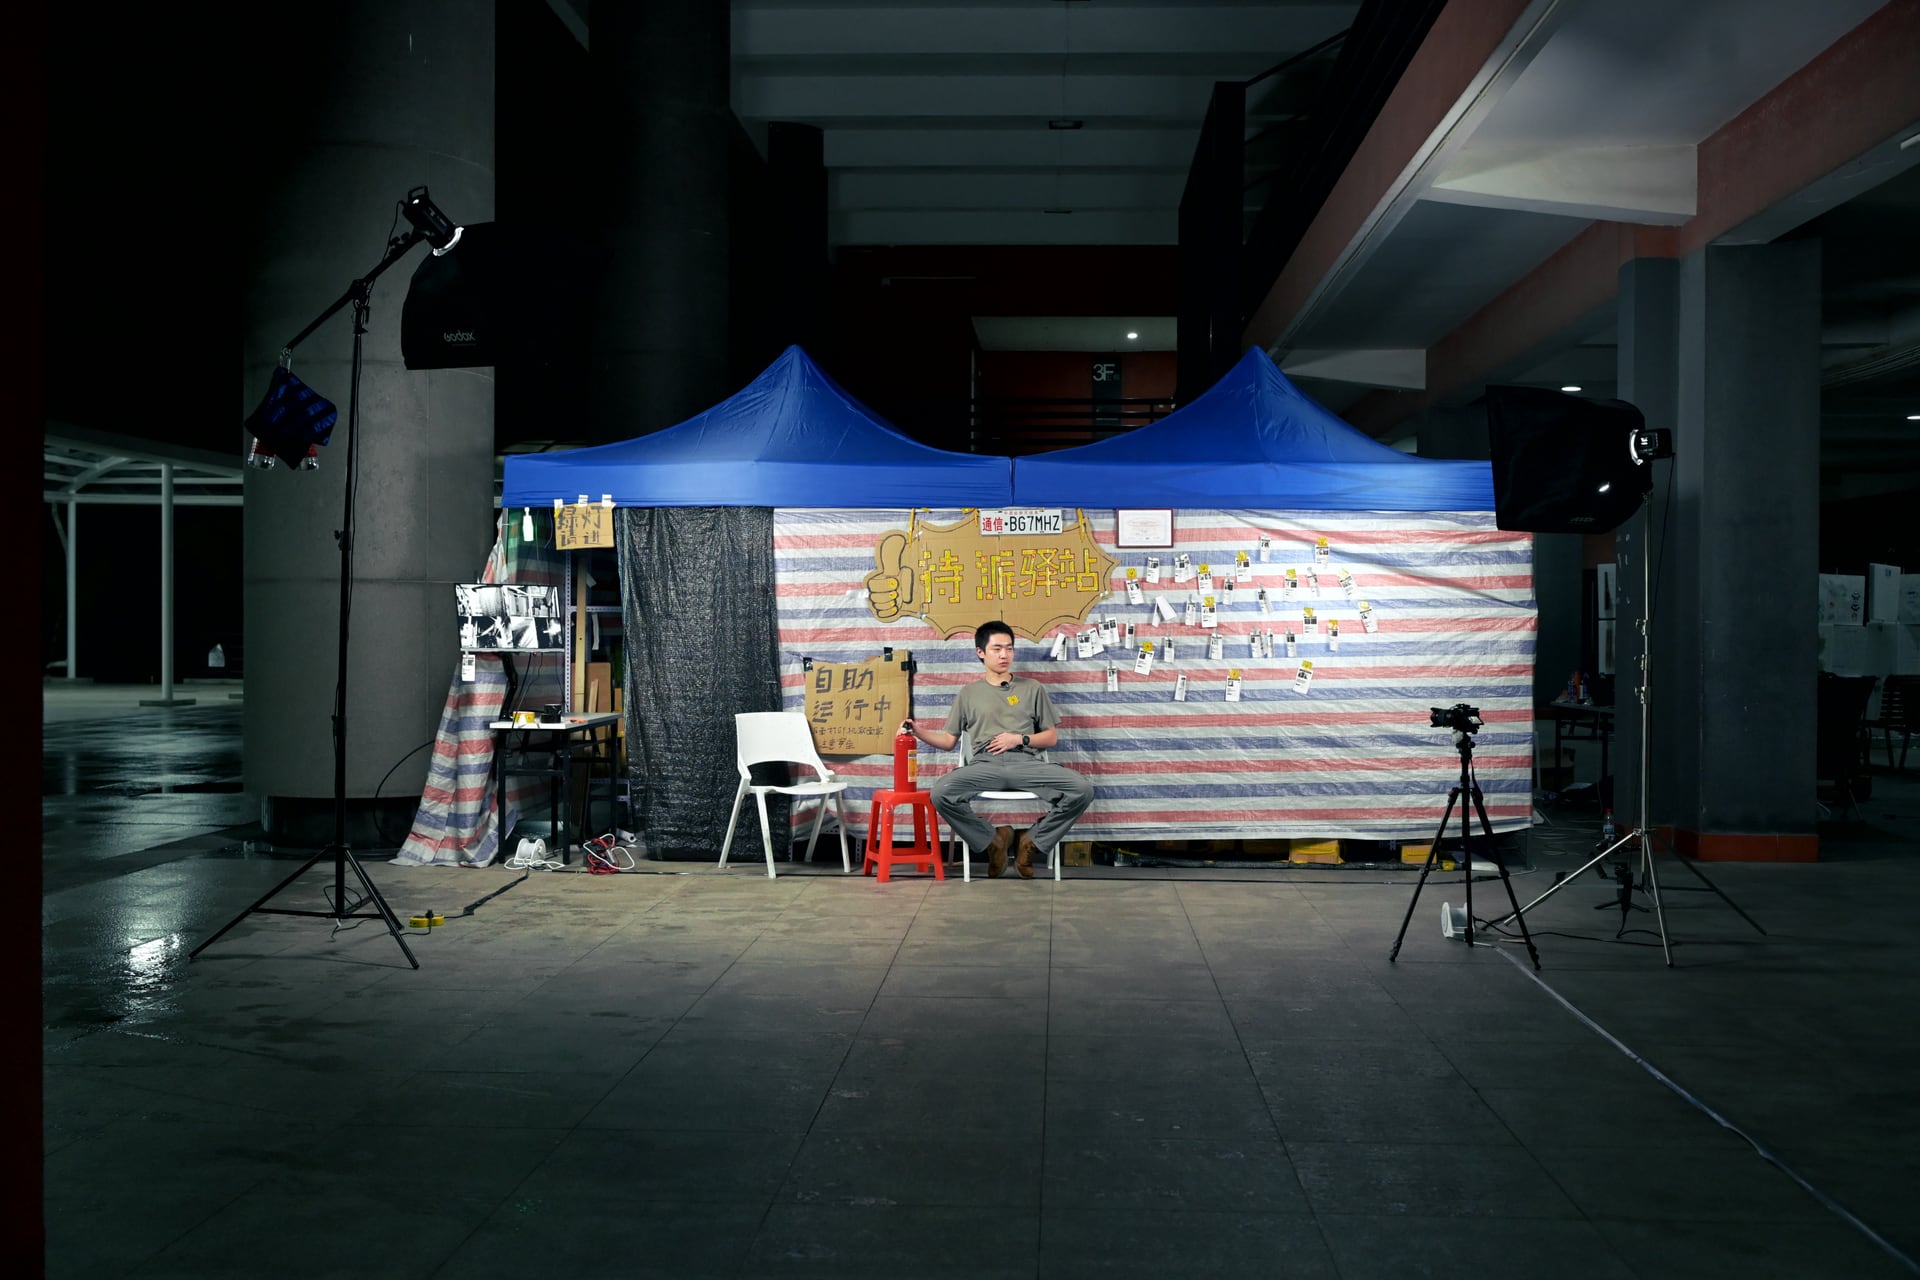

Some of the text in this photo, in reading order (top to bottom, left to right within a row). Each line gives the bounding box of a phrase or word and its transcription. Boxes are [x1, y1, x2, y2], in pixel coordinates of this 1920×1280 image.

[1092, 363, 1116, 381] 3F
[557, 505, 605, 537] 绿灯
[815, 666, 874, 694] 自助
[812, 694, 892, 723] 运行中
